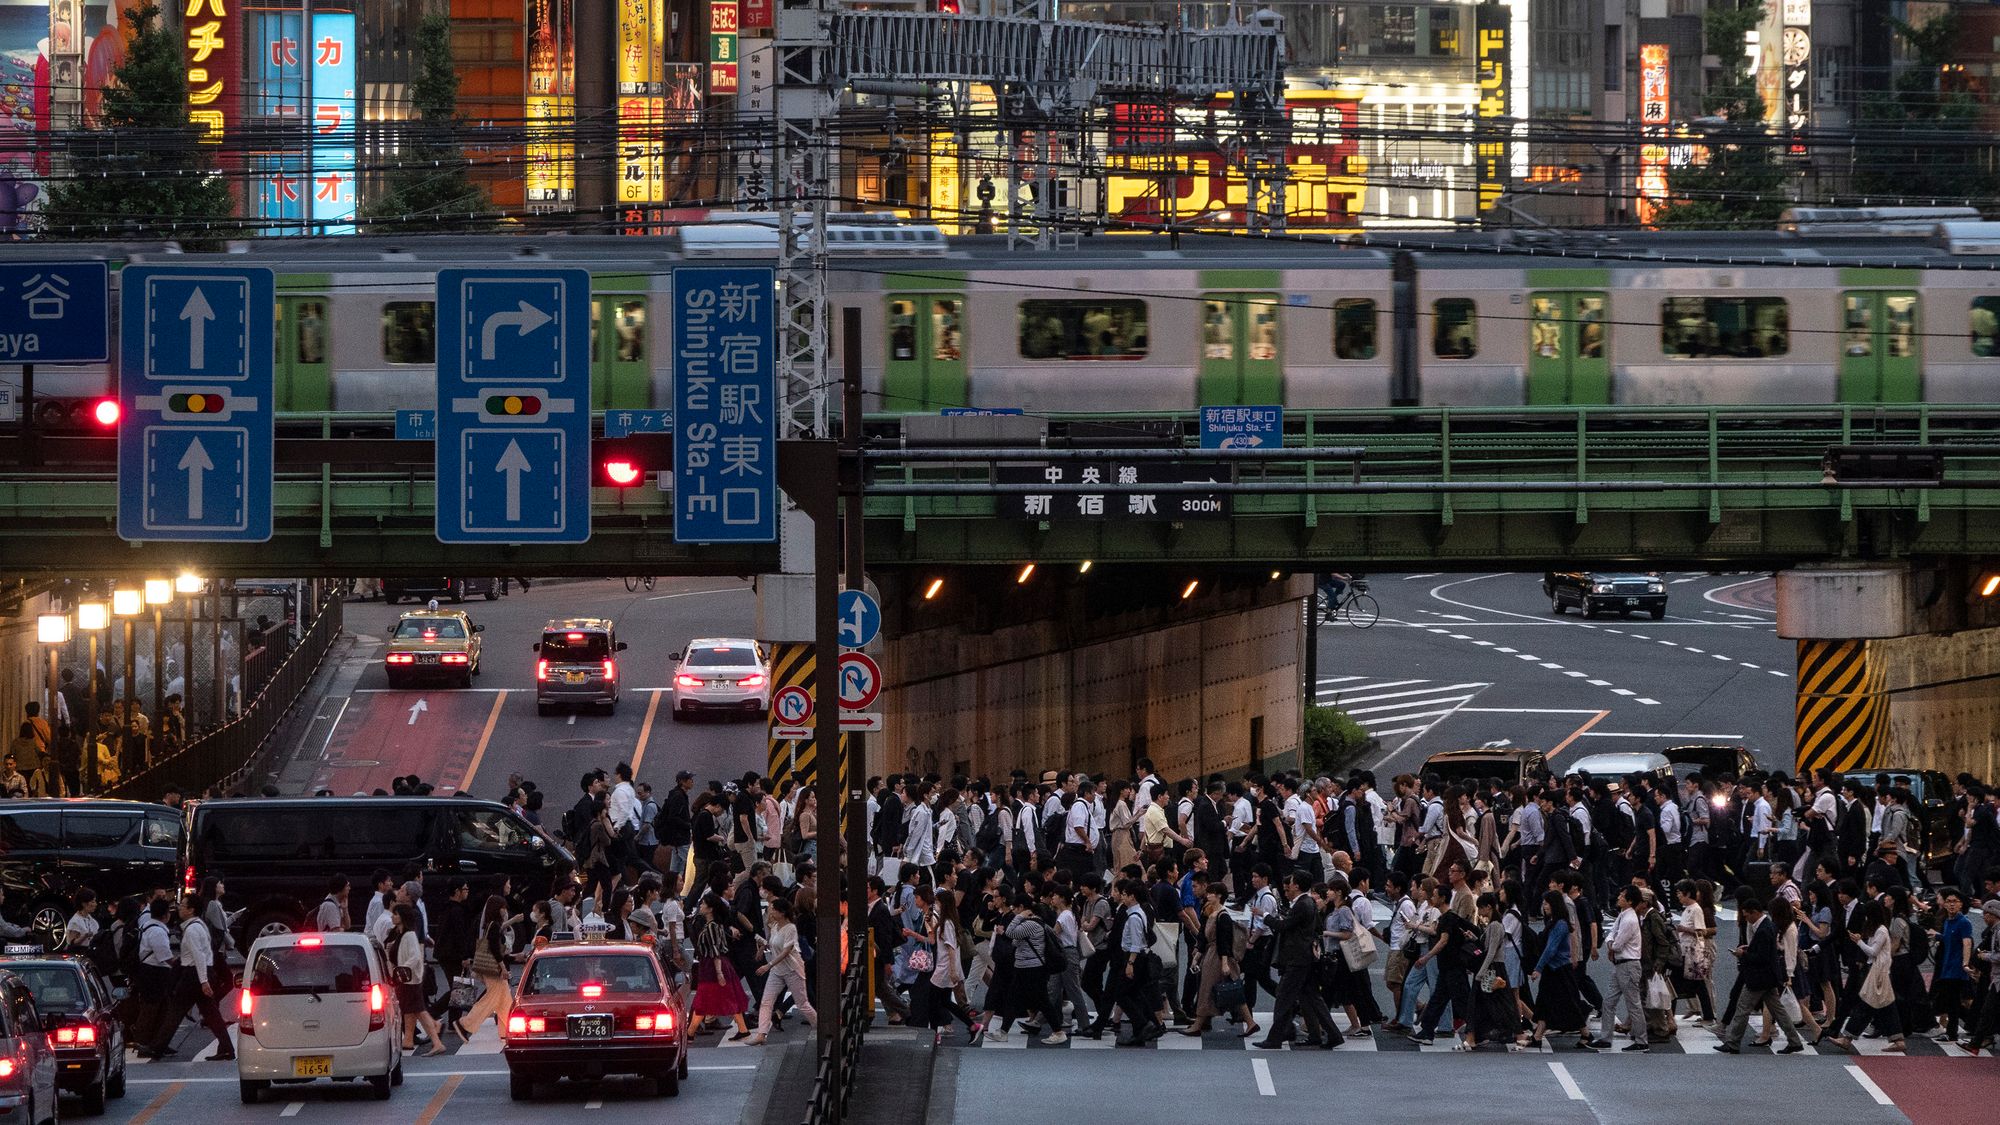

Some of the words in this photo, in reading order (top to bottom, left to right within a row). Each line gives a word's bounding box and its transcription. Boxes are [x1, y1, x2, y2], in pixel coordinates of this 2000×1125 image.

[712, 7, 736, 28] たばこ
[718, 37, 731, 59] 酒
[680, 288, 715, 410] Shinjuku
[718, 281, 763, 525] 新宿駅東口
[1206, 408, 1276, 423] 新宿駅東口
[1208, 423, 1243, 433] Shinjuku
[1045, 466, 1138, 484] 中央線
[304, 1064, 329, 1075] 16-54
